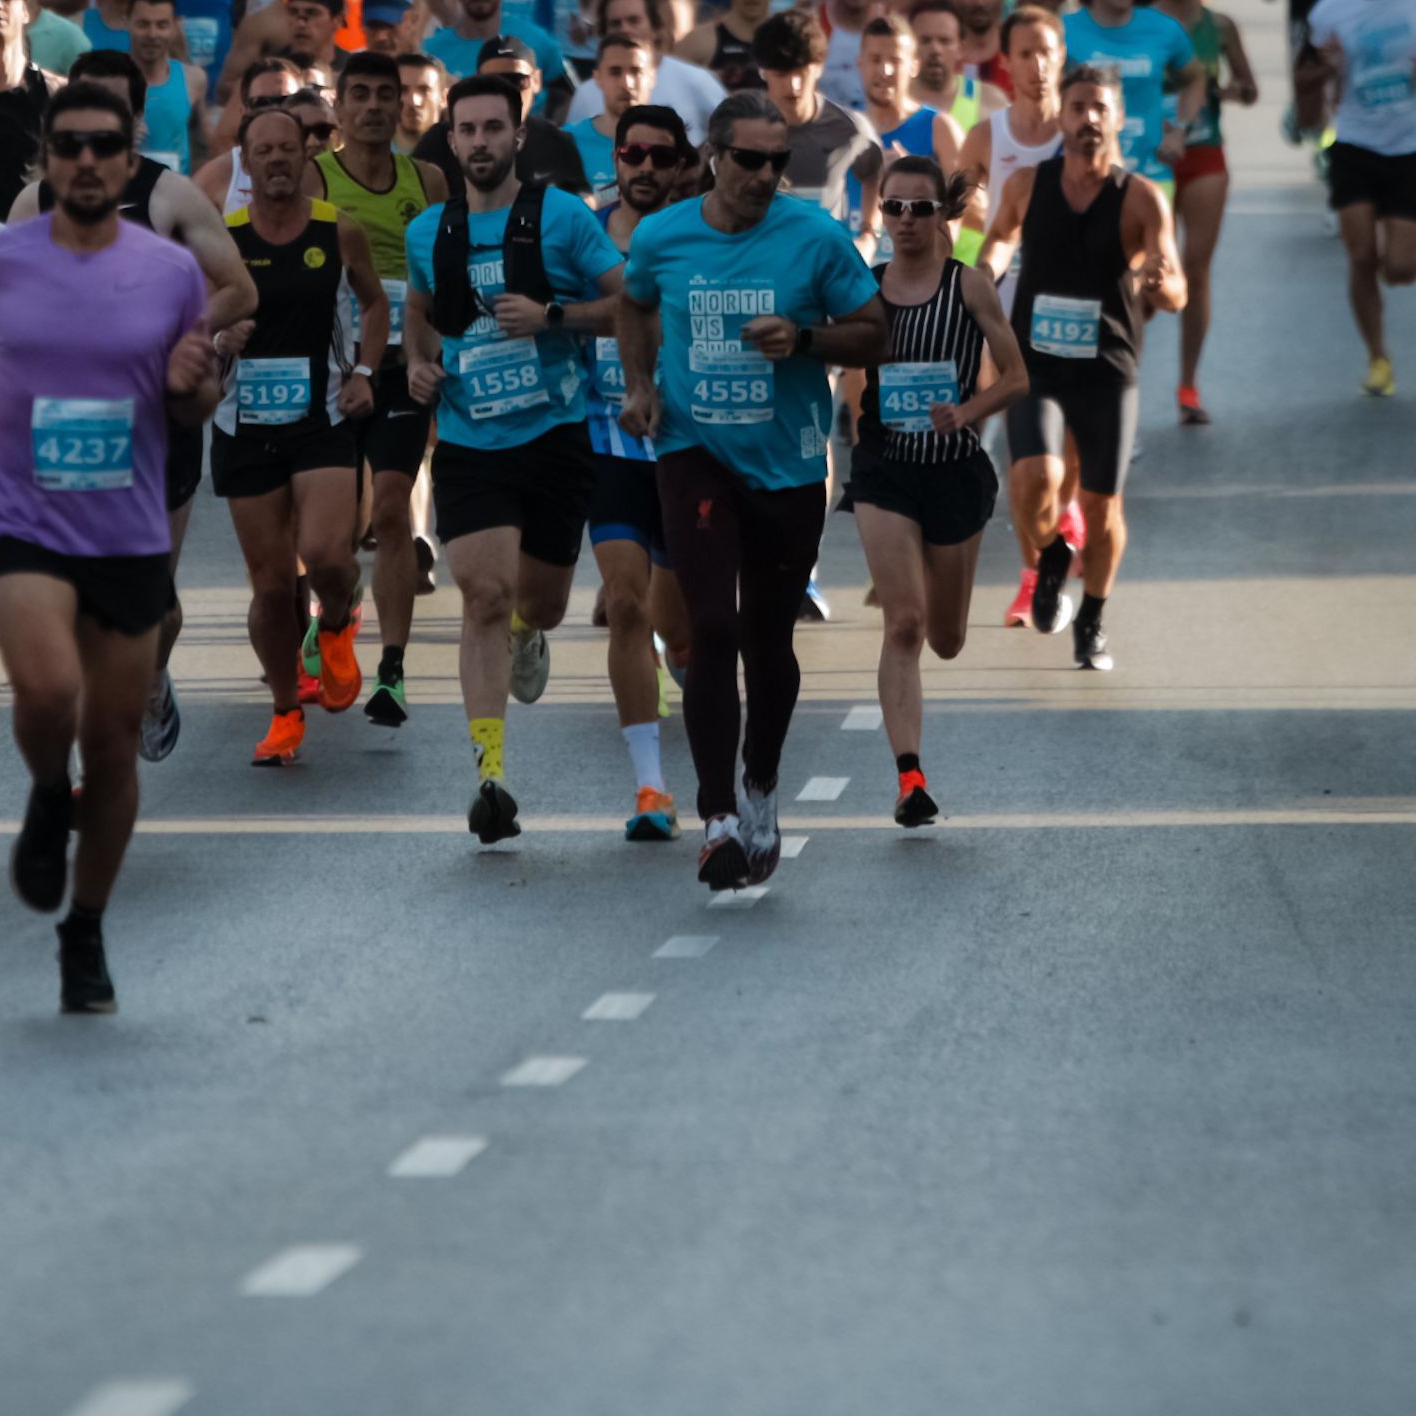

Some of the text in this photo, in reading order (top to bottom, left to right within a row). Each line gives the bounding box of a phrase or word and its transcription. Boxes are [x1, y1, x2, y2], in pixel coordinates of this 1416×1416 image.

[690, 291, 773, 313] NORTE
[692, 317, 722, 338] VS
[1034, 319, 1095, 341] 4192
[470, 365, 538, 397] 1558
[693, 380, 768, 402] 4558
[239, 384, 305, 404] 5192
[885, 389, 953, 411] 4832
[37, 437, 128, 463] 4237
